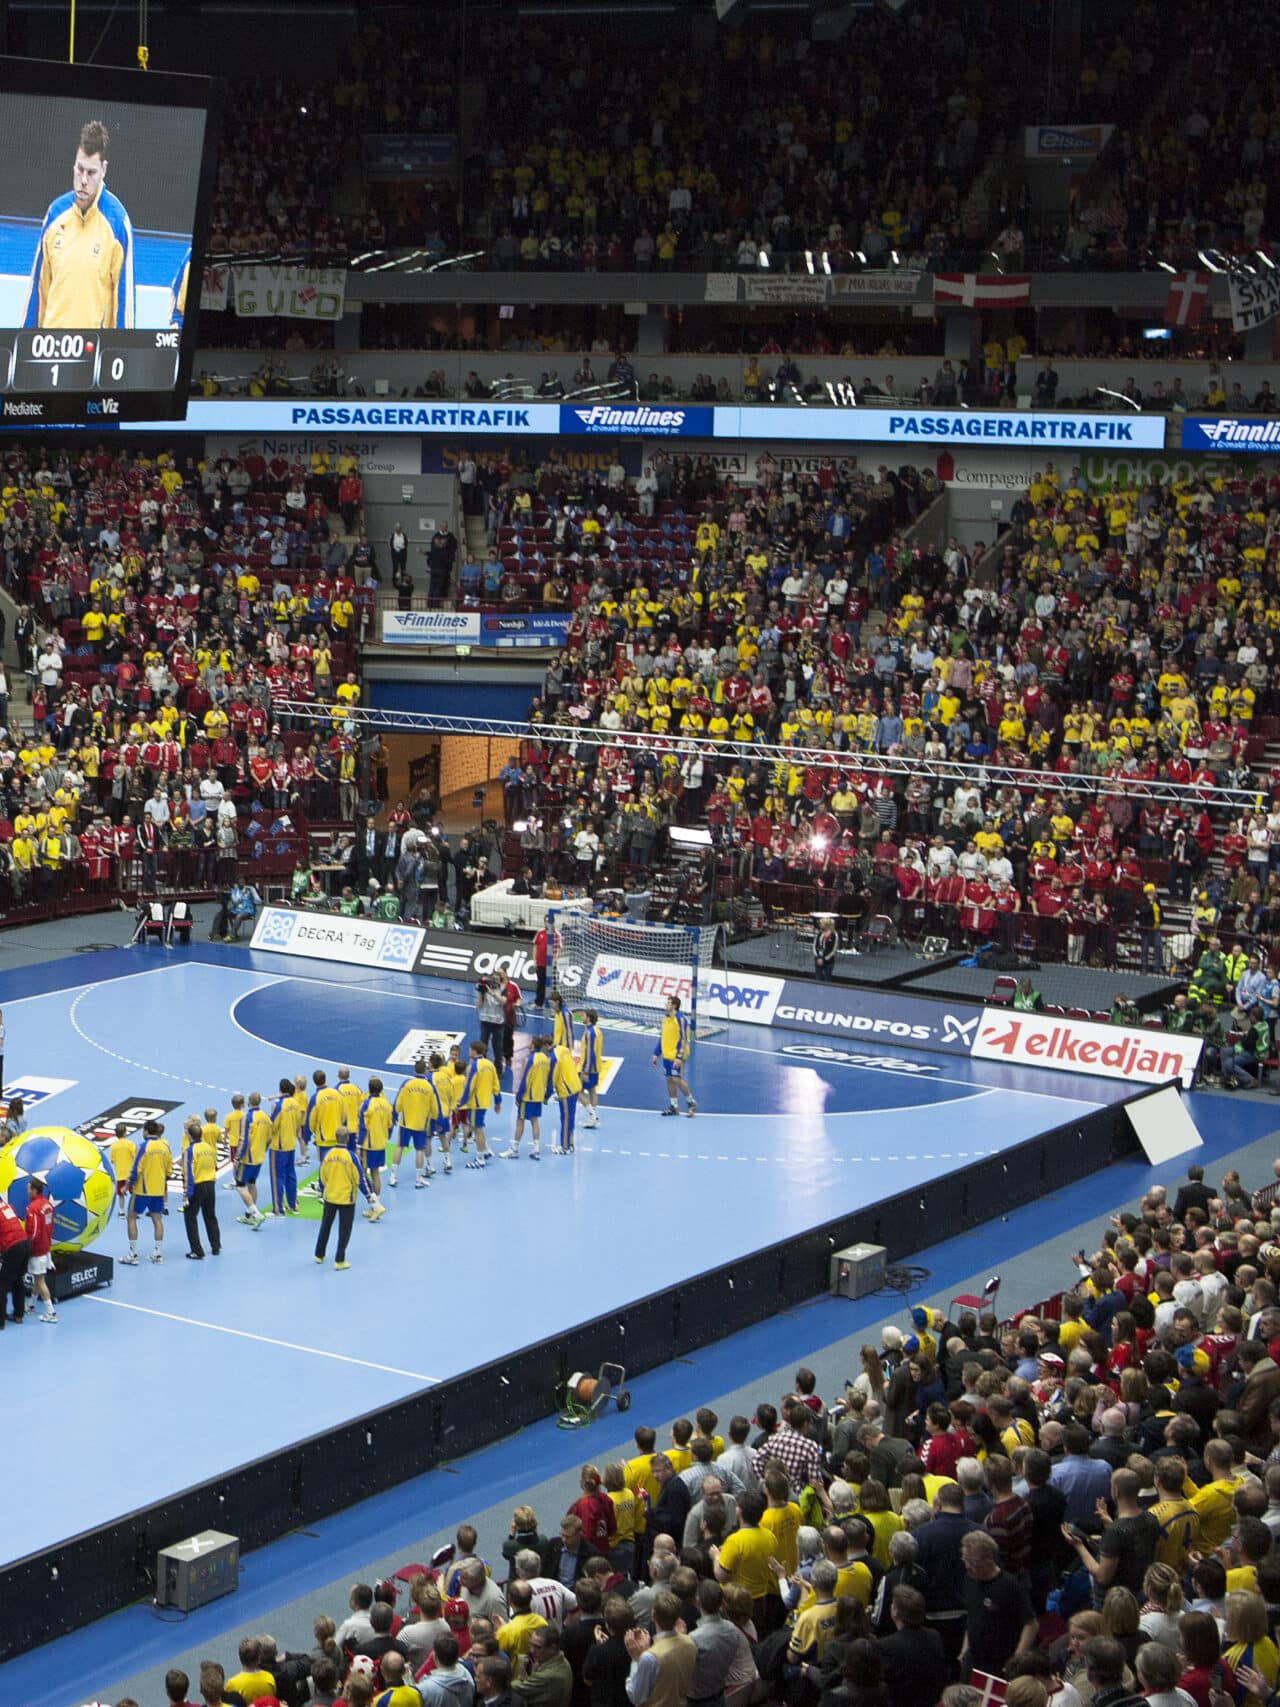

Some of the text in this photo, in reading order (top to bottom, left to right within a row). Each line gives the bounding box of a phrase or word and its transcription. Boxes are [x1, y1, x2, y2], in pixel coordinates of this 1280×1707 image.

[31, 334, 84, 358] 00:00
[155, 332, 179, 348] SWE
[50, 364, 59, 387] 1
[111, 358, 124, 381] 0
[3, 402, 43, 416] Mediatec
[86, 398, 119, 414] tecViz
[292, 408, 530, 426] PASSAGERARTRAFIK
[588, 407, 685, 425] Finnlines
[890, 416, 1132, 440] PASSAGERARTRAFIK
[404, 613, 469, 628] Finnlines
[297, 926, 377, 951] DECRA Tag
[473, 949, 583, 987] adis
[620, 971, 770, 1010] INTERPORT
[776, 1006, 930, 1040] GRUNDFOS
[1025, 1028, 1183, 1076] elkedjan
[71, 1267, 98, 1285] SELECT
[542, 1594, 557, 1619] 11
